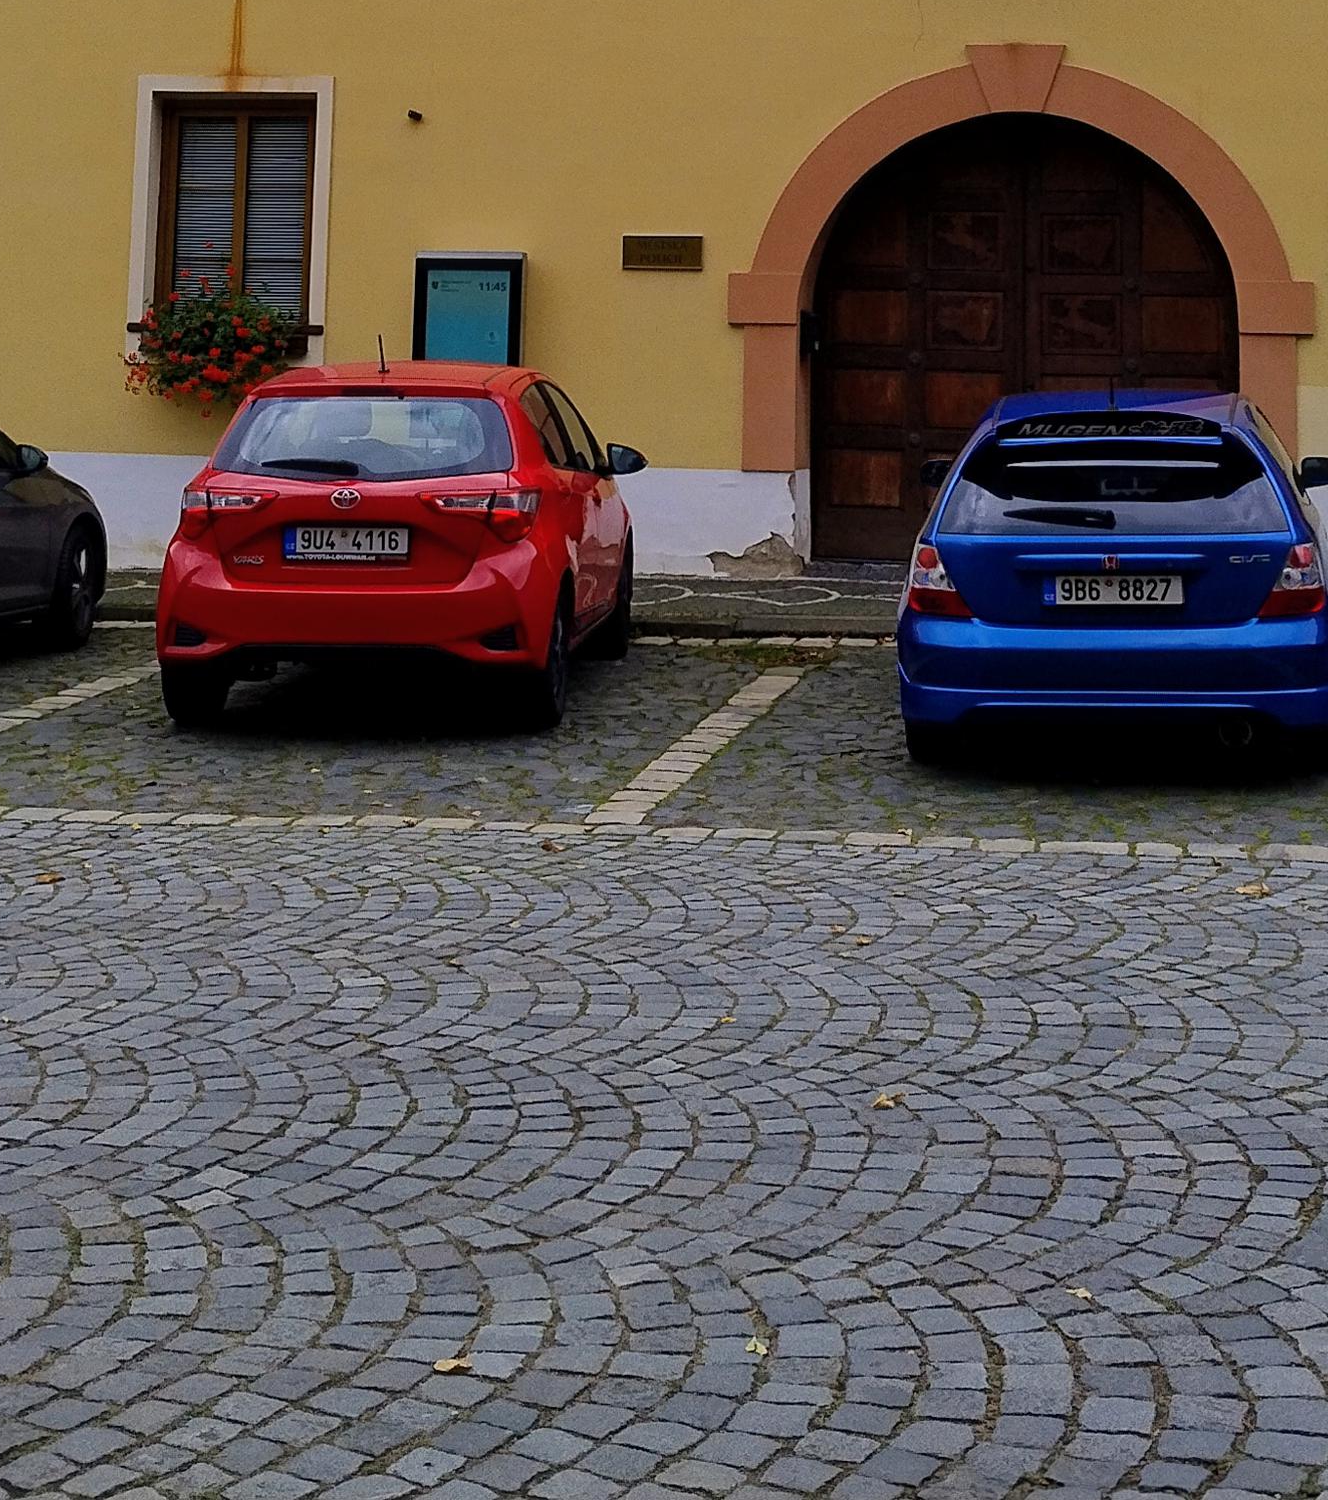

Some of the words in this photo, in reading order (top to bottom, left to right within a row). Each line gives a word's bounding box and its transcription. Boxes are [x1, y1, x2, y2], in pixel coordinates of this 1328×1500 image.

[479, 282, 507, 292] 11:45
[1018, 423, 1128, 436] MUGEN
[300, 530, 336, 550] 9U4
[351, 531, 400, 551] 4116
[1060, 578, 1101, 601] 9B6
[1118, 578, 1173, 602] 8827
